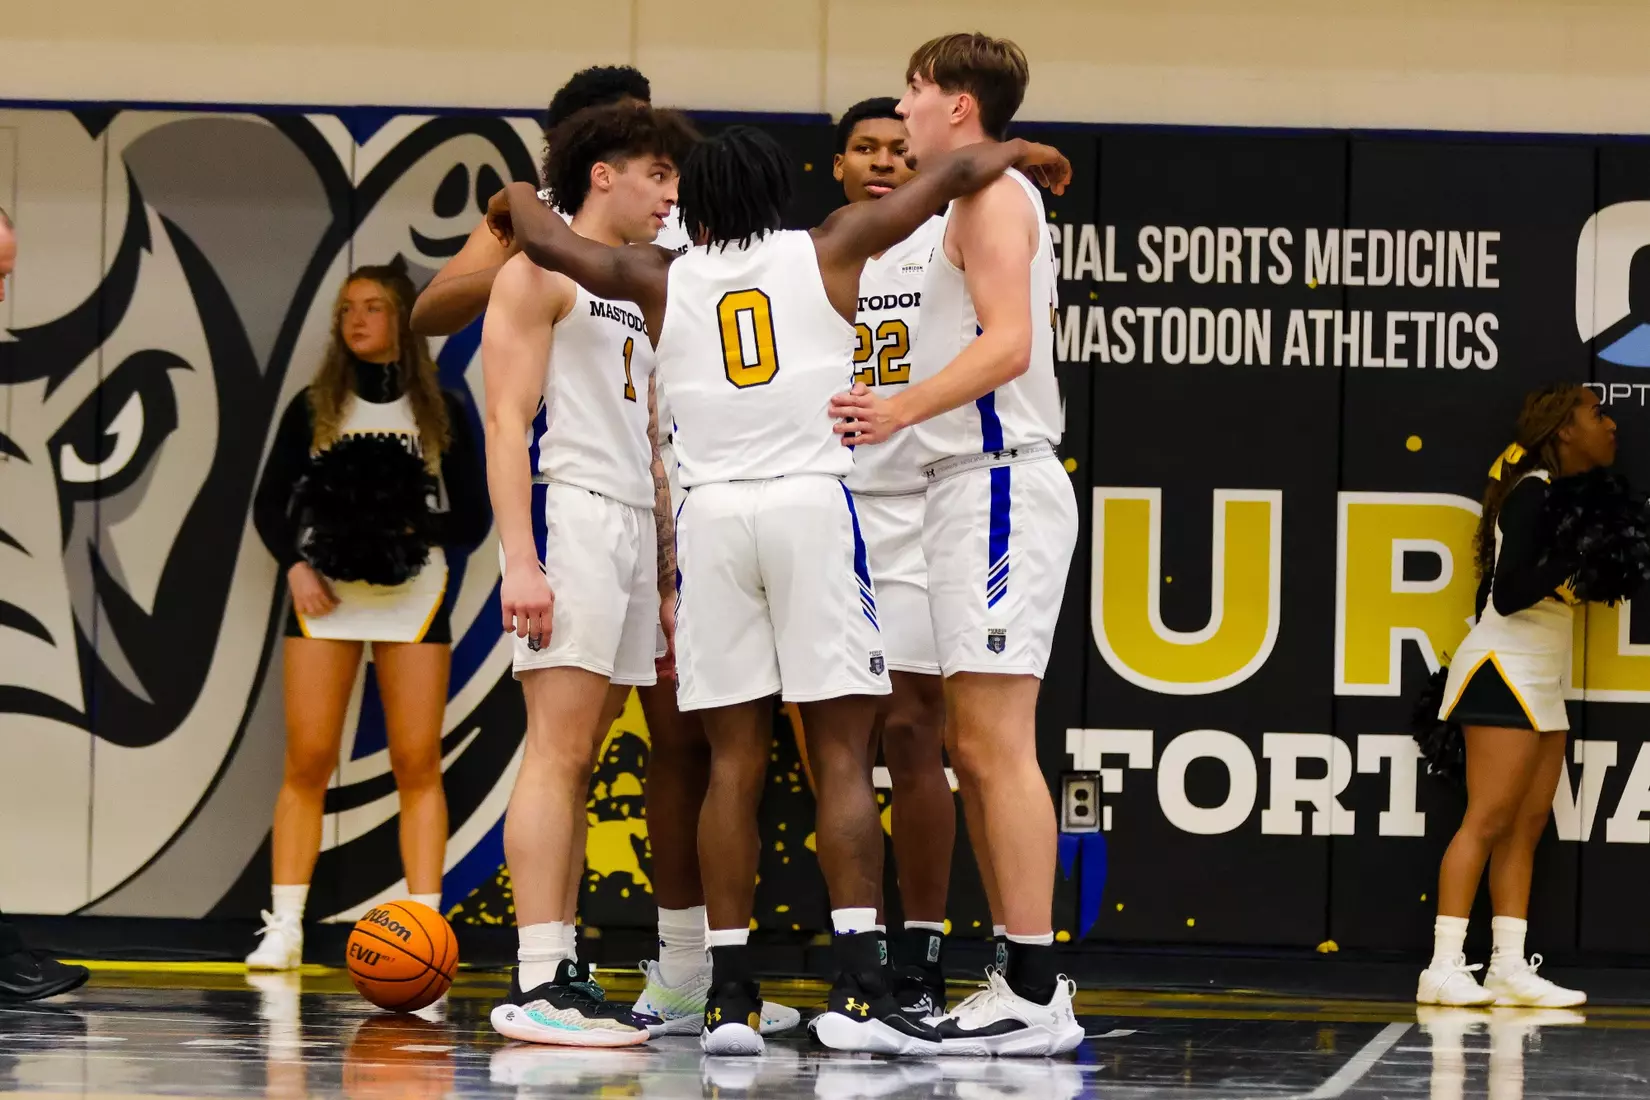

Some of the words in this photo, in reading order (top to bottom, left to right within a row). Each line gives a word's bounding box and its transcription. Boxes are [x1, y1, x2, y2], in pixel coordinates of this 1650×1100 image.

[1137, 225, 1293, 285] SPORTS
[1305, 228, 1501, 289] MEDICINE
[623, 336, 637, 403] 1
[716, 287, 780, 389] 0
[853, 319, 911, 387] 22
[1056, 305, 1272, 366] MASTODON
[1283, 309, 1499, 370] ATHLETICS
[1065, 728, 1426, 837] FORT
